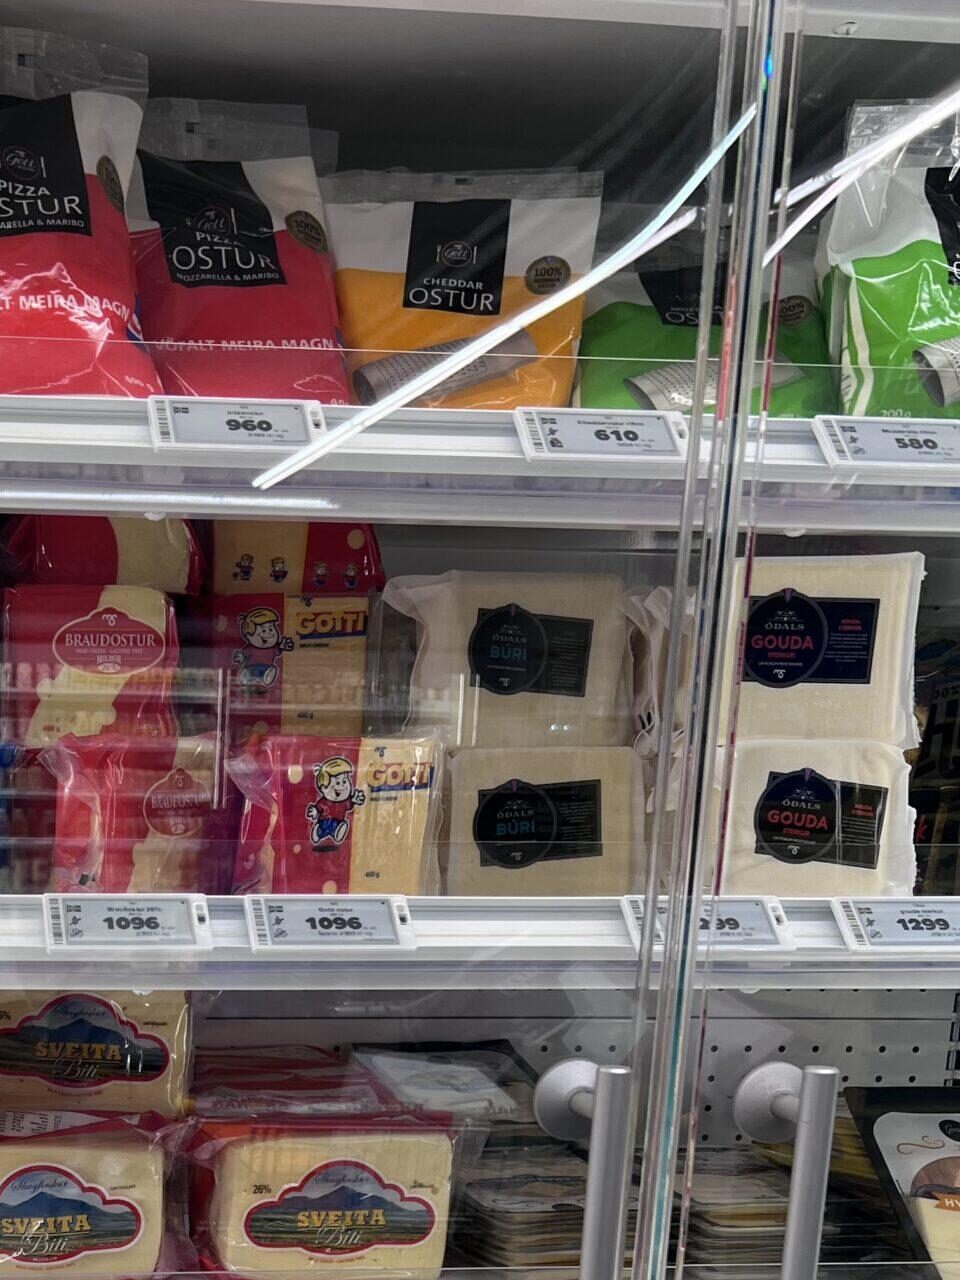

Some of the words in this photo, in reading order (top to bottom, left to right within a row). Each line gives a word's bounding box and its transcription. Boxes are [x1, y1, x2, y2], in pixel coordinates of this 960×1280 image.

[46, 217, 85, 229] MARIBO
[171, 245, 277, 271] OSTUR
[243, 271, 280, 280] MARIBO
[422, 276, 484, 291] CHEDDAR
[18, 293, 77, 311] MEIRA
[408, 286, 495, 312] OSTUR
[226, 419, 273, 432] 960
[594, 429, 640, 442] 610
[895, 436, 940, 451] 580
[296, 609, 368, 638] GOTTI
[765, 619, 806, 632] ÓDALS
[750, 635, 815, 651] GOUDA
[490, 641, 528, 662] BÚRI
[365, 760, 434, 790] GOTTI
[782, 799, 822, 811] ÓDALS
[766, 809, 829, 831] GOUDA
[495, 820, 536, 837] BÚRI
[103, 916, 161, 931] 1096
[305, 916, 363, 931] 1096
[896, 918, 950, 932] 1299
[35, 1041, 123, 1061] SVEITA
[252, 1184, 273, 1196] 26%
[1, 1214, 91, 1236] SVEITA
[297, 1207, 387, 1230] SVEITA
